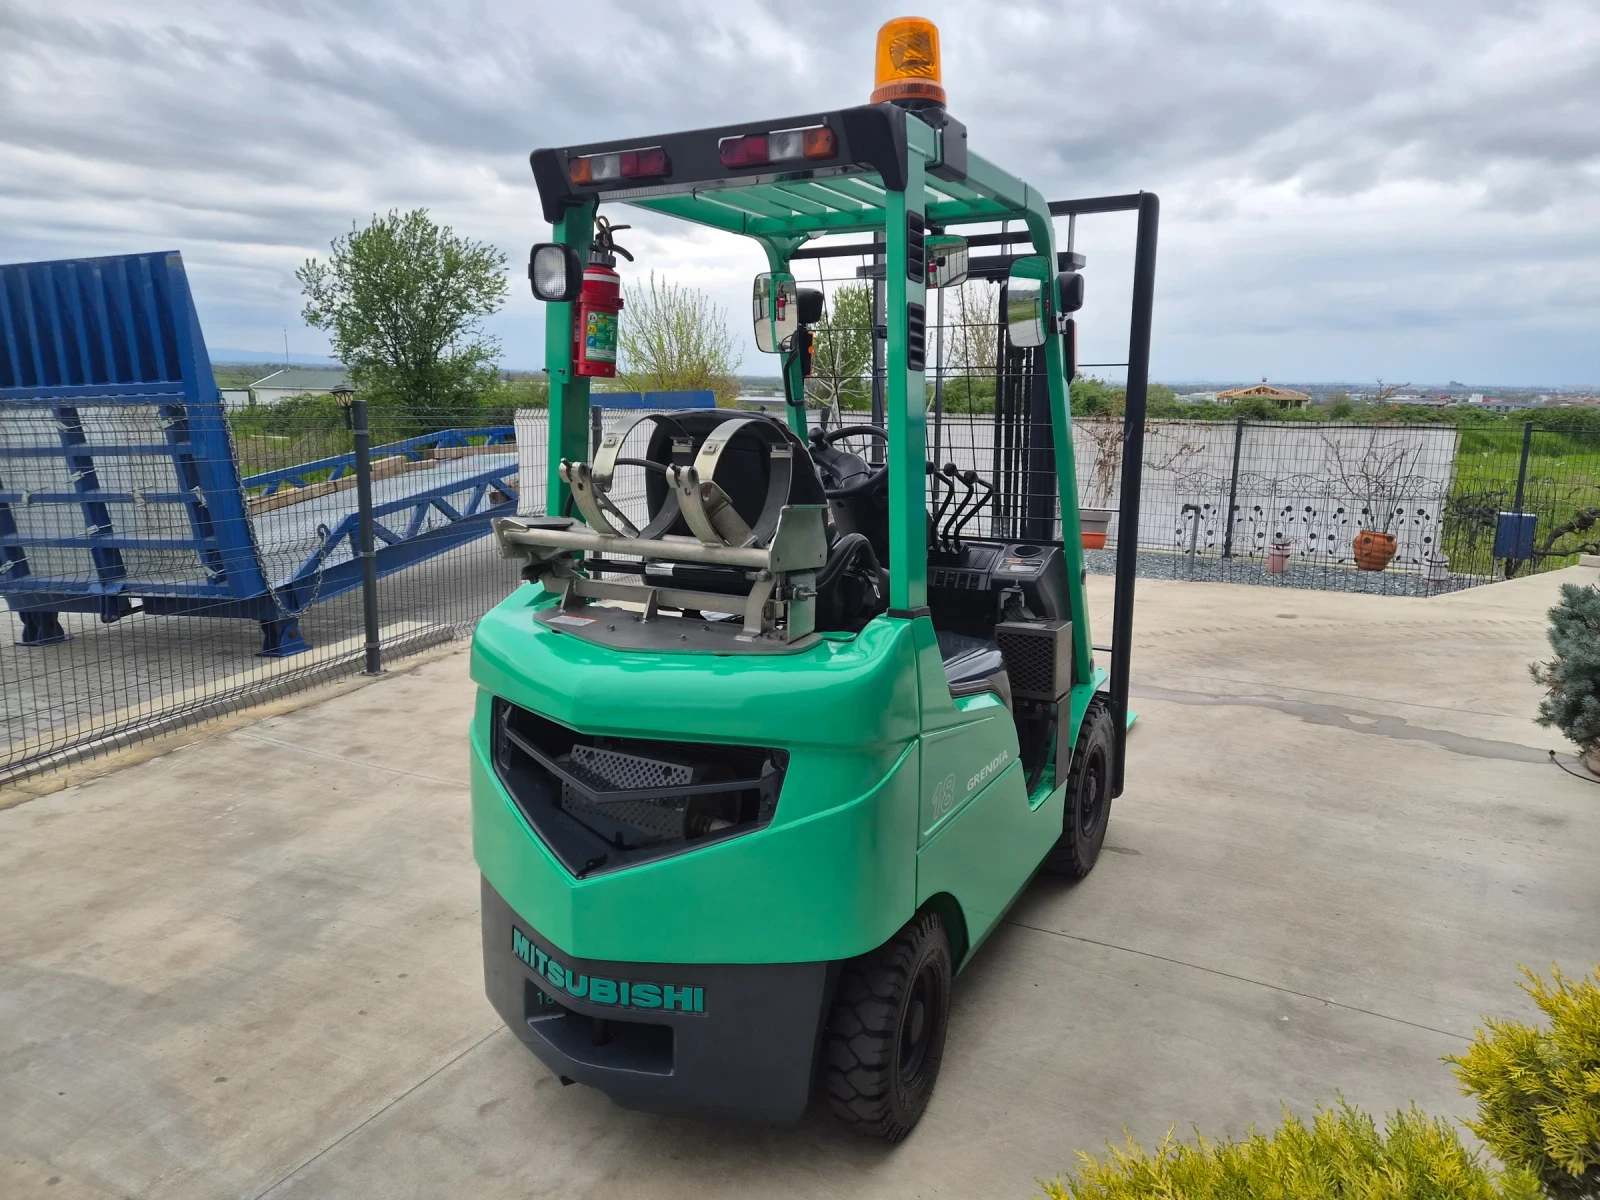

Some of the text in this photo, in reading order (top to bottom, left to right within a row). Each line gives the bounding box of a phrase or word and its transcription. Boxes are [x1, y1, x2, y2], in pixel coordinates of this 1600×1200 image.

[966, 749, 1009, 792] GRENDIA
[931, 772, 956, 821] 18
[513, 926, 705, 1013] MITSUBISHI
